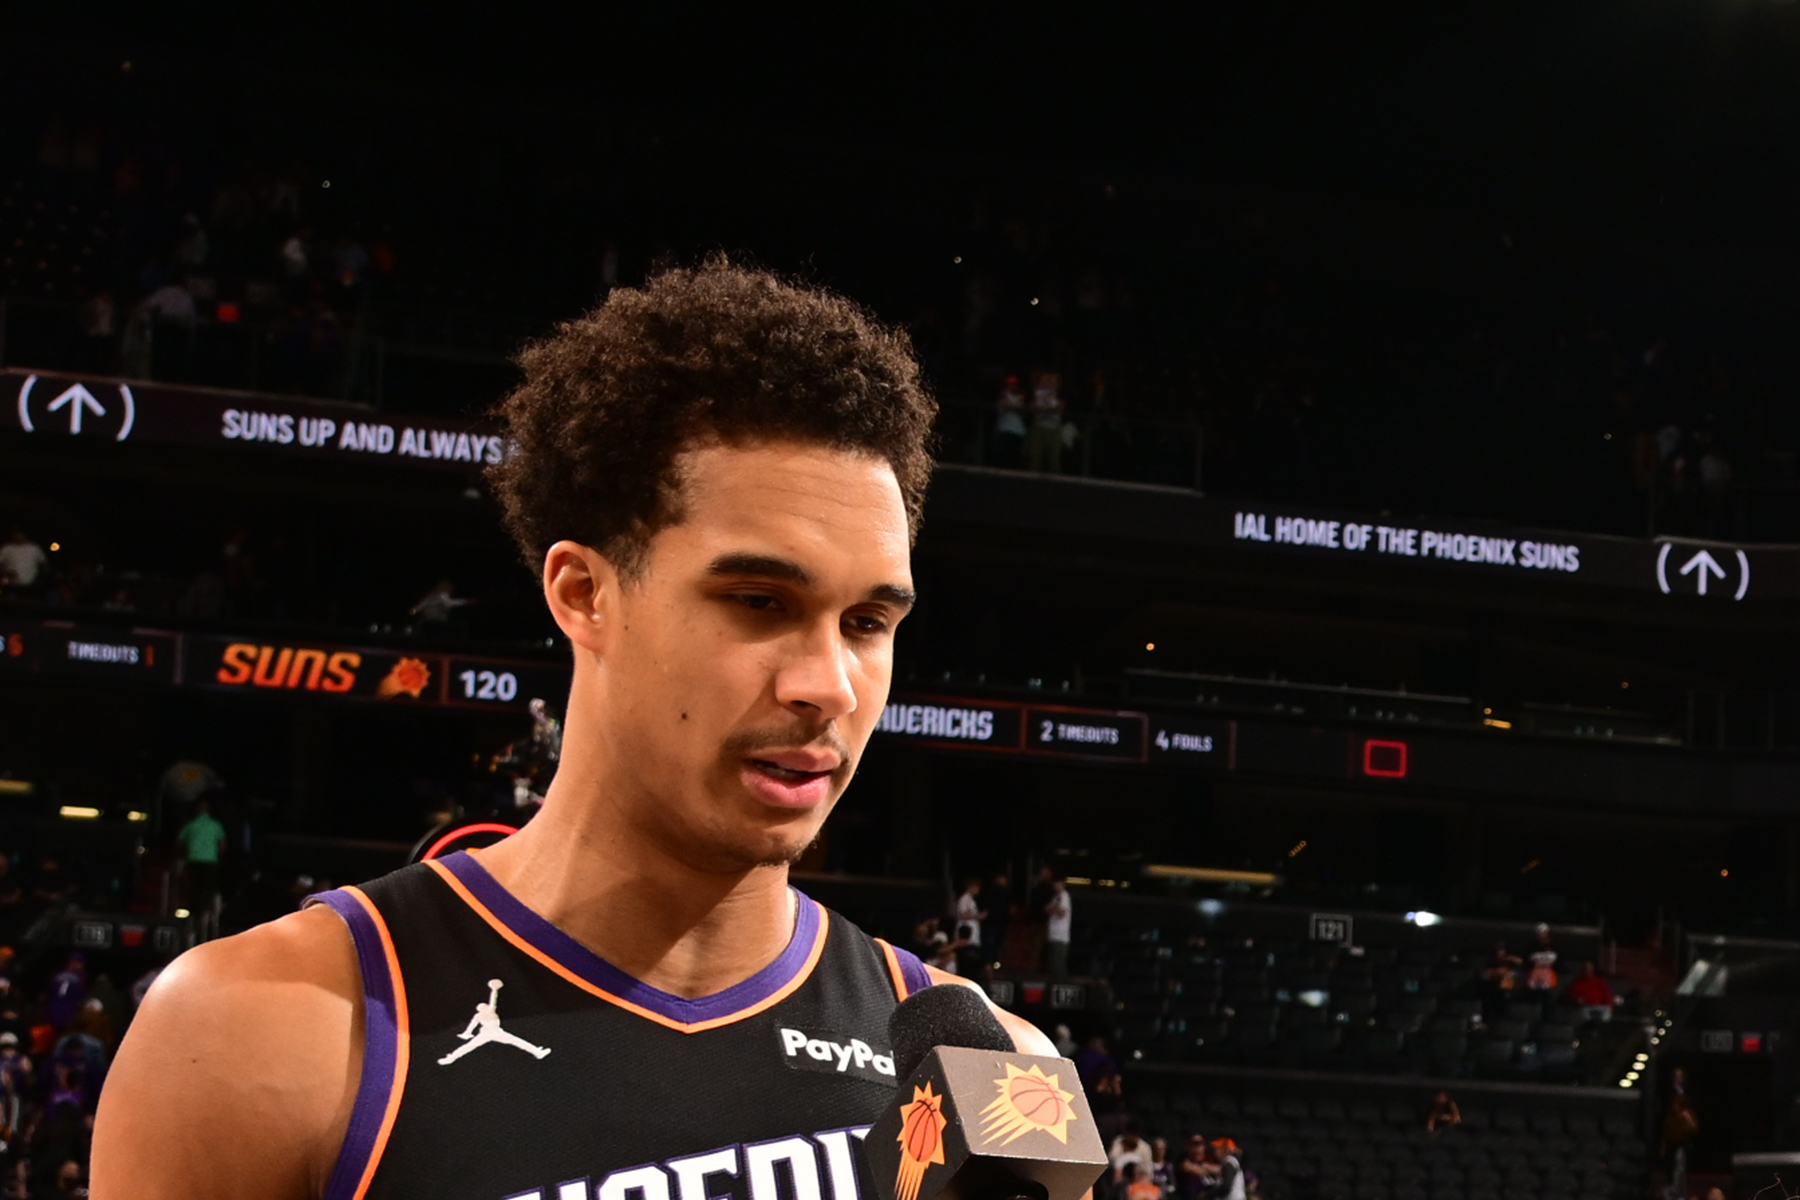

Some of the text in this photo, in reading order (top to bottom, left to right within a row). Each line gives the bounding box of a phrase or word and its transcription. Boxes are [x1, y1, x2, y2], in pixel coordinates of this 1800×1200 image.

[221, 409, 504, 465] SUNS UP AND ALWAYS
[1274, 516, 1340, 549] HOME
[1343, 522, 1374, 551] OF
[1375, 525, 1418, 557] THE
[1421, 529, 1517, 566] PHOENIX
[1518, 539, 1581, 573] SUNS
[67, 640, 140, 665] TIMEOUTS
[216, 642, 363, 694] SUNS
[459, 669, 519, 702] 120
[1040, 720, 1121, 746] 2 TIMEOUTS
[1155, 729, 1213, 753] 4 FOULS
[780, 1028, 897, 1076] PayPa
